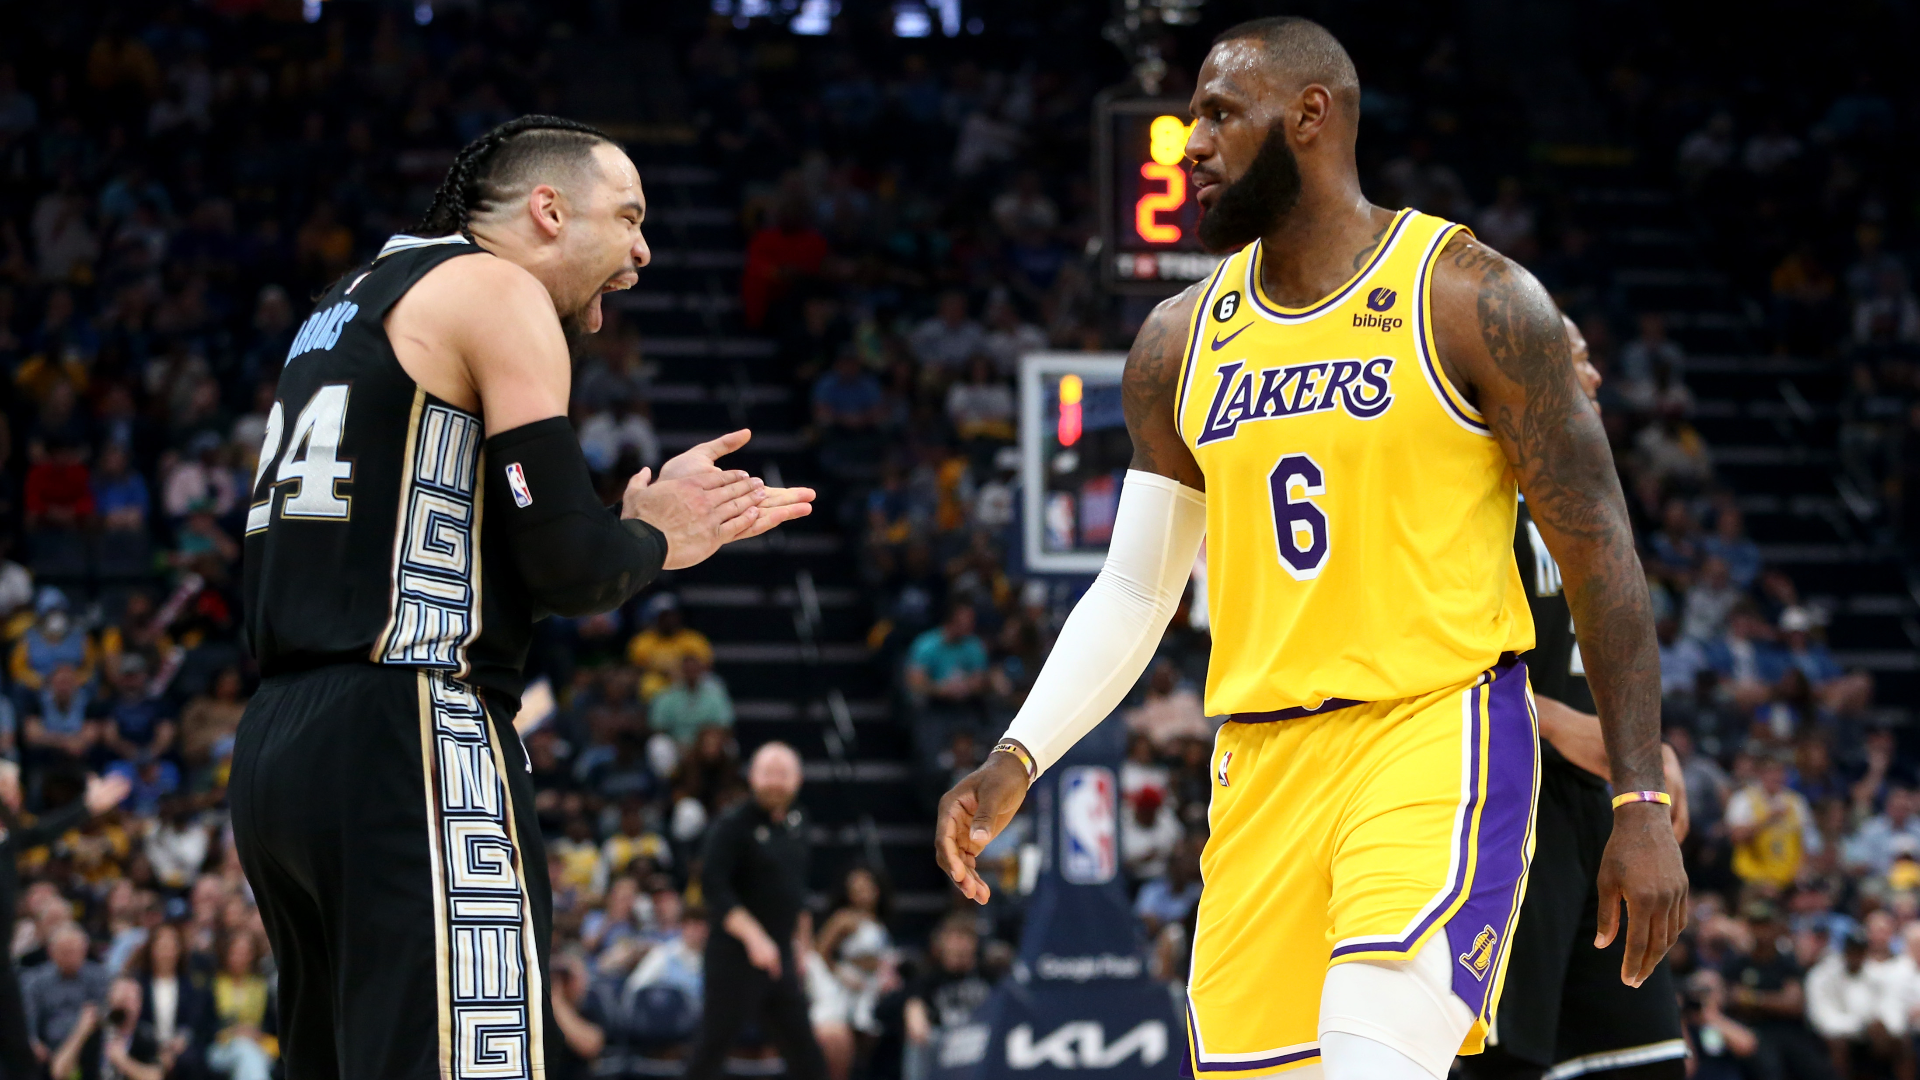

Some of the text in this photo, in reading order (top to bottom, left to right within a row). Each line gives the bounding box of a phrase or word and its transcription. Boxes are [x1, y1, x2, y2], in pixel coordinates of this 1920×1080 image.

[1219, 294, 1236, 320] 6
[1352, 313, 1403, 333] bibigo
[1196, 356, 1396, 449] LAKERS
[1267, 452, 1330, 581] 6
